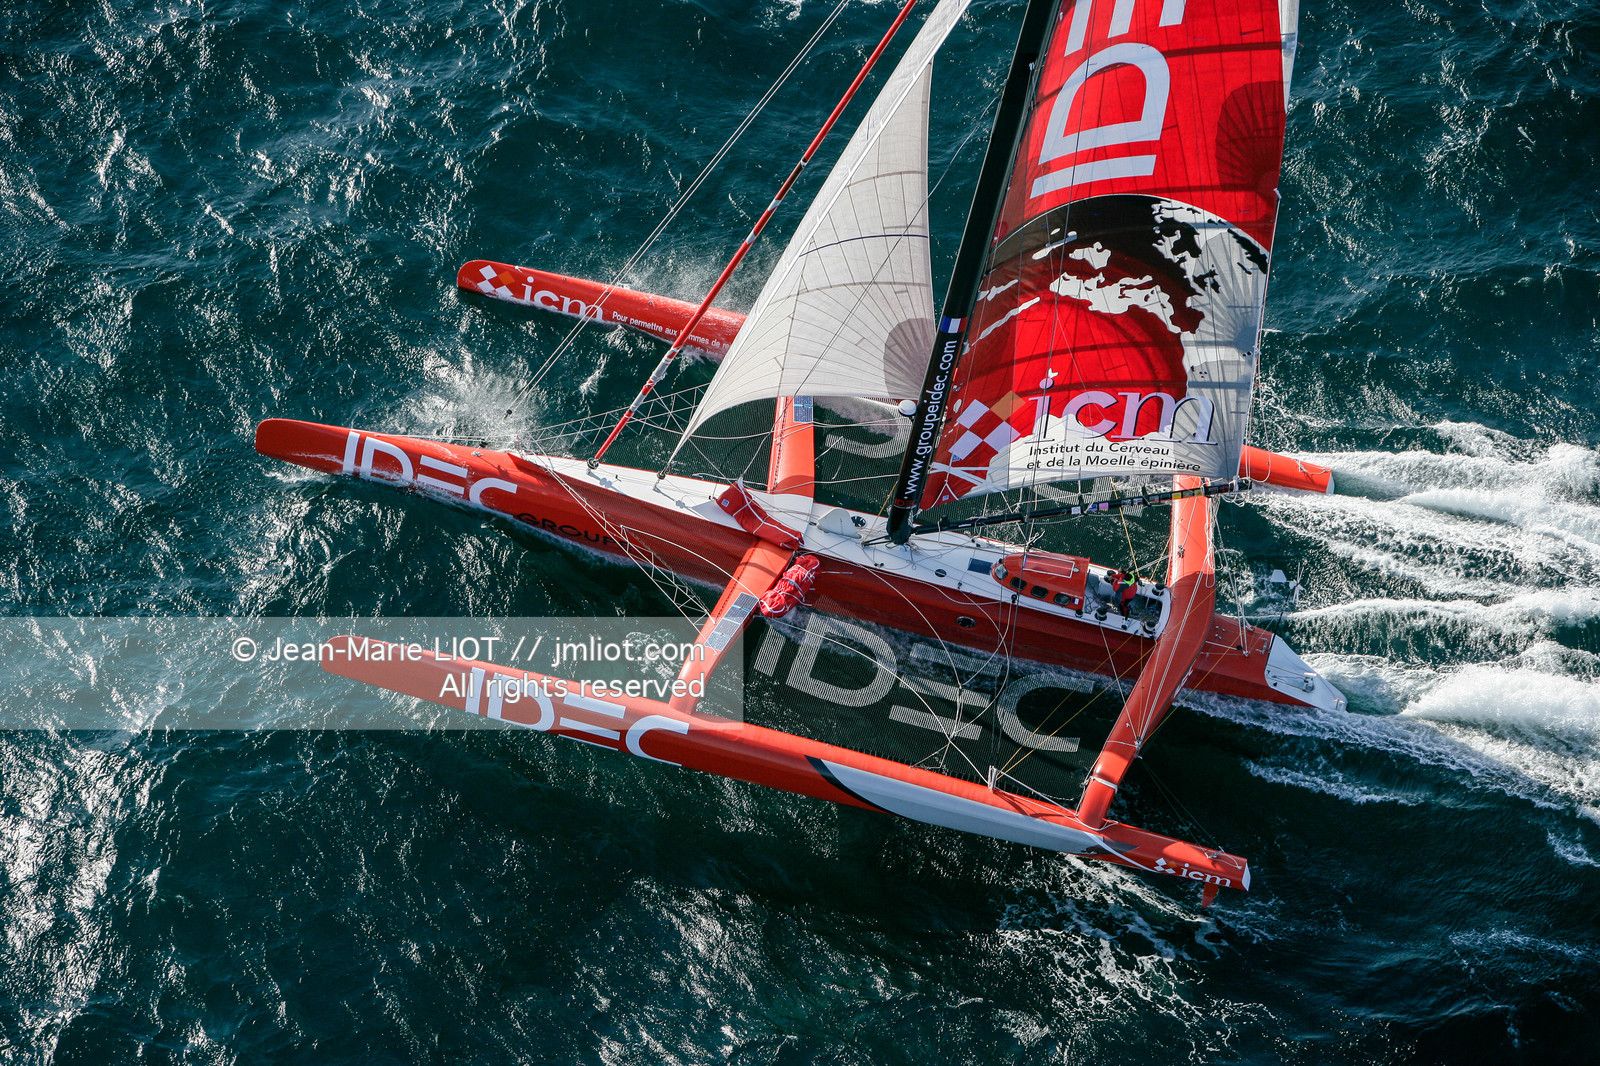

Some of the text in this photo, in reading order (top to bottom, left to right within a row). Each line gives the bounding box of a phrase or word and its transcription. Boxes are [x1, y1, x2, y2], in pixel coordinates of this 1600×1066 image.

[520, 276, 604, 322] icm
[612, 311, 628, 322] Pour
[630, 318, 663, 333] permettre
[665, 328, 678, 337] aux
[711, 338, 721, 347] de
[905, 340, 957, 495] www.groupeidec.com
[1024, 375, 1219, 446] icm
[342, 430, 518, 519] IDEC
[1026, 455, 1201, 473] et de la Moelle épinière
[1029, 442, 1170, 456] Institut du Cerveau
[753, 612, 1096, 753] IDEC
[465, 666, 690, 767] IDEC
[1180, 862, 1232, 888] icm
